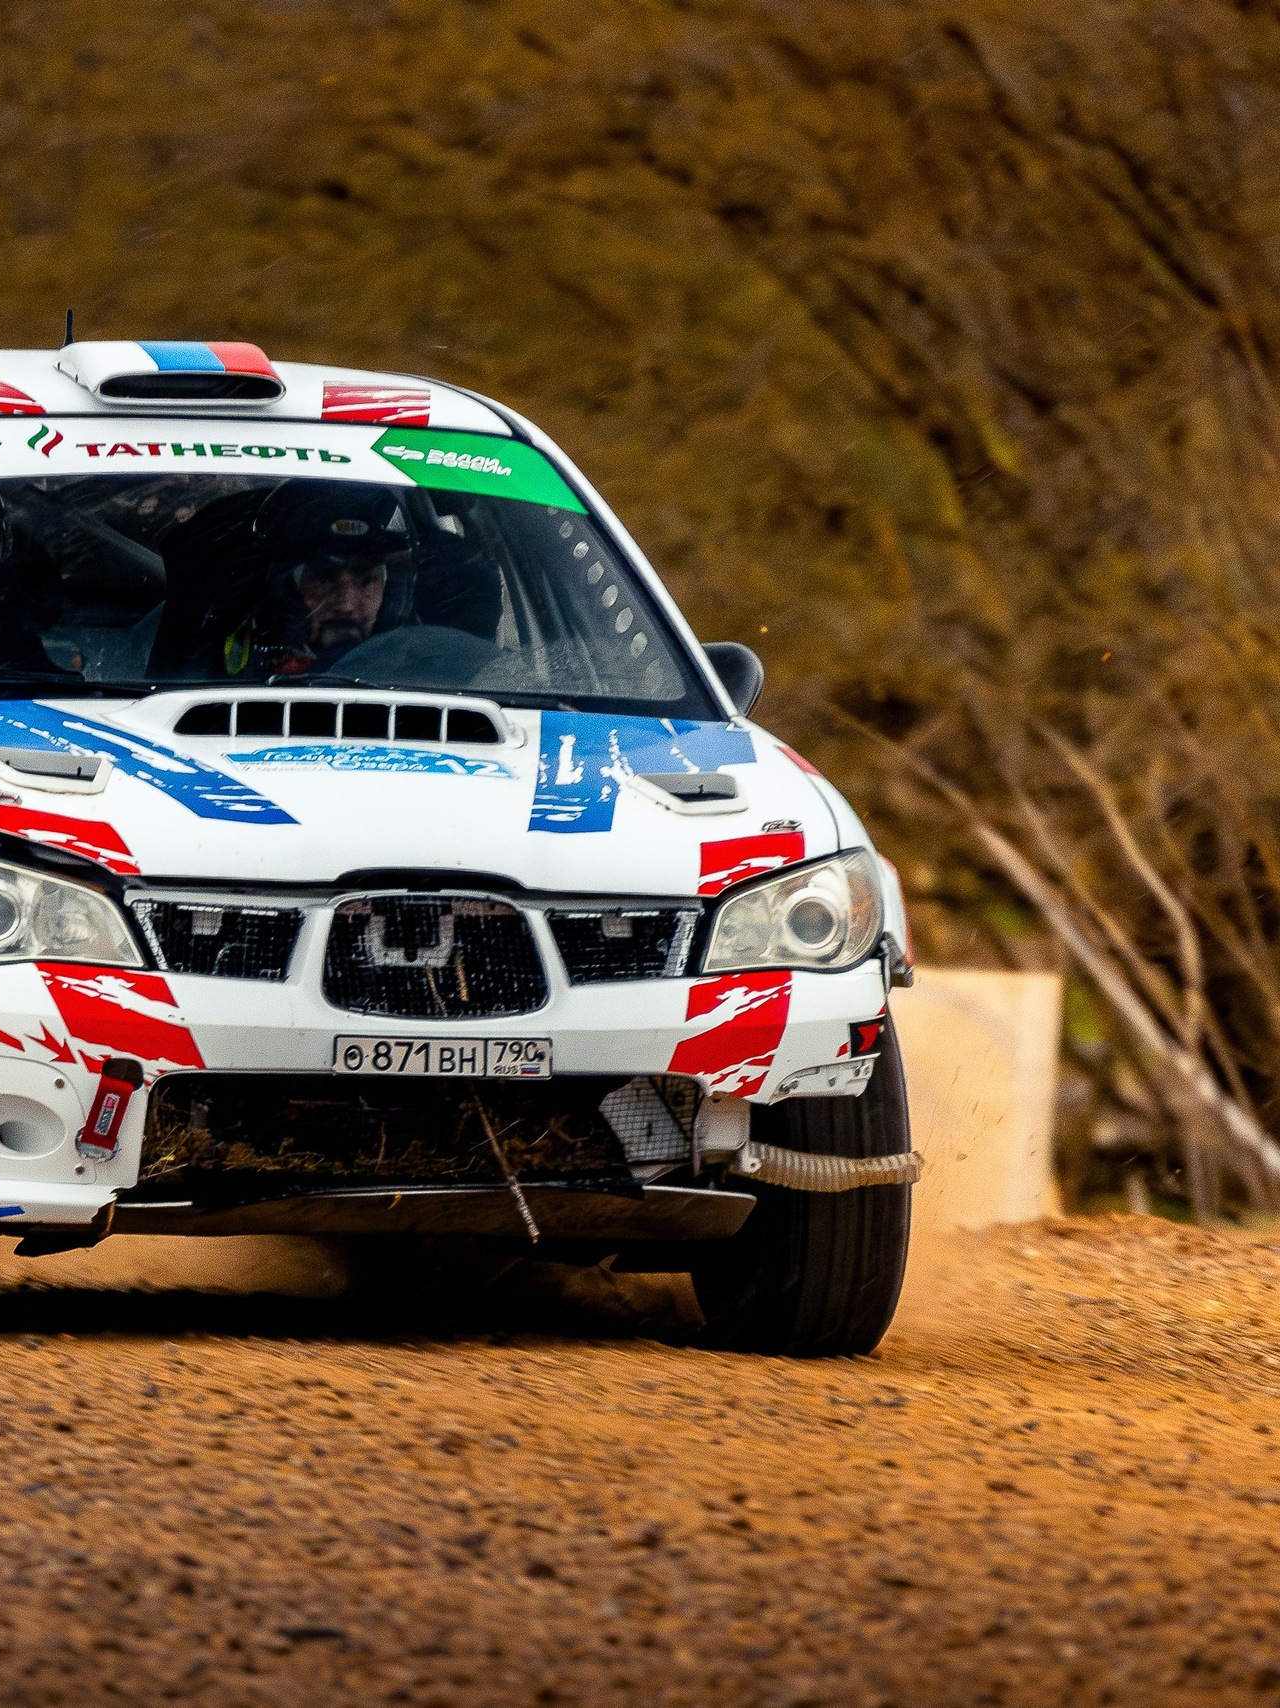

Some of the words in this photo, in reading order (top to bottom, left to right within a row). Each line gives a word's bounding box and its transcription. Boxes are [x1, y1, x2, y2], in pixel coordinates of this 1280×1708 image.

[75, 442, 352, 464] ТАТНЕФТЬ
[434, 758, 510, 779] 12
[371, 1040, 431, 1074] 871
